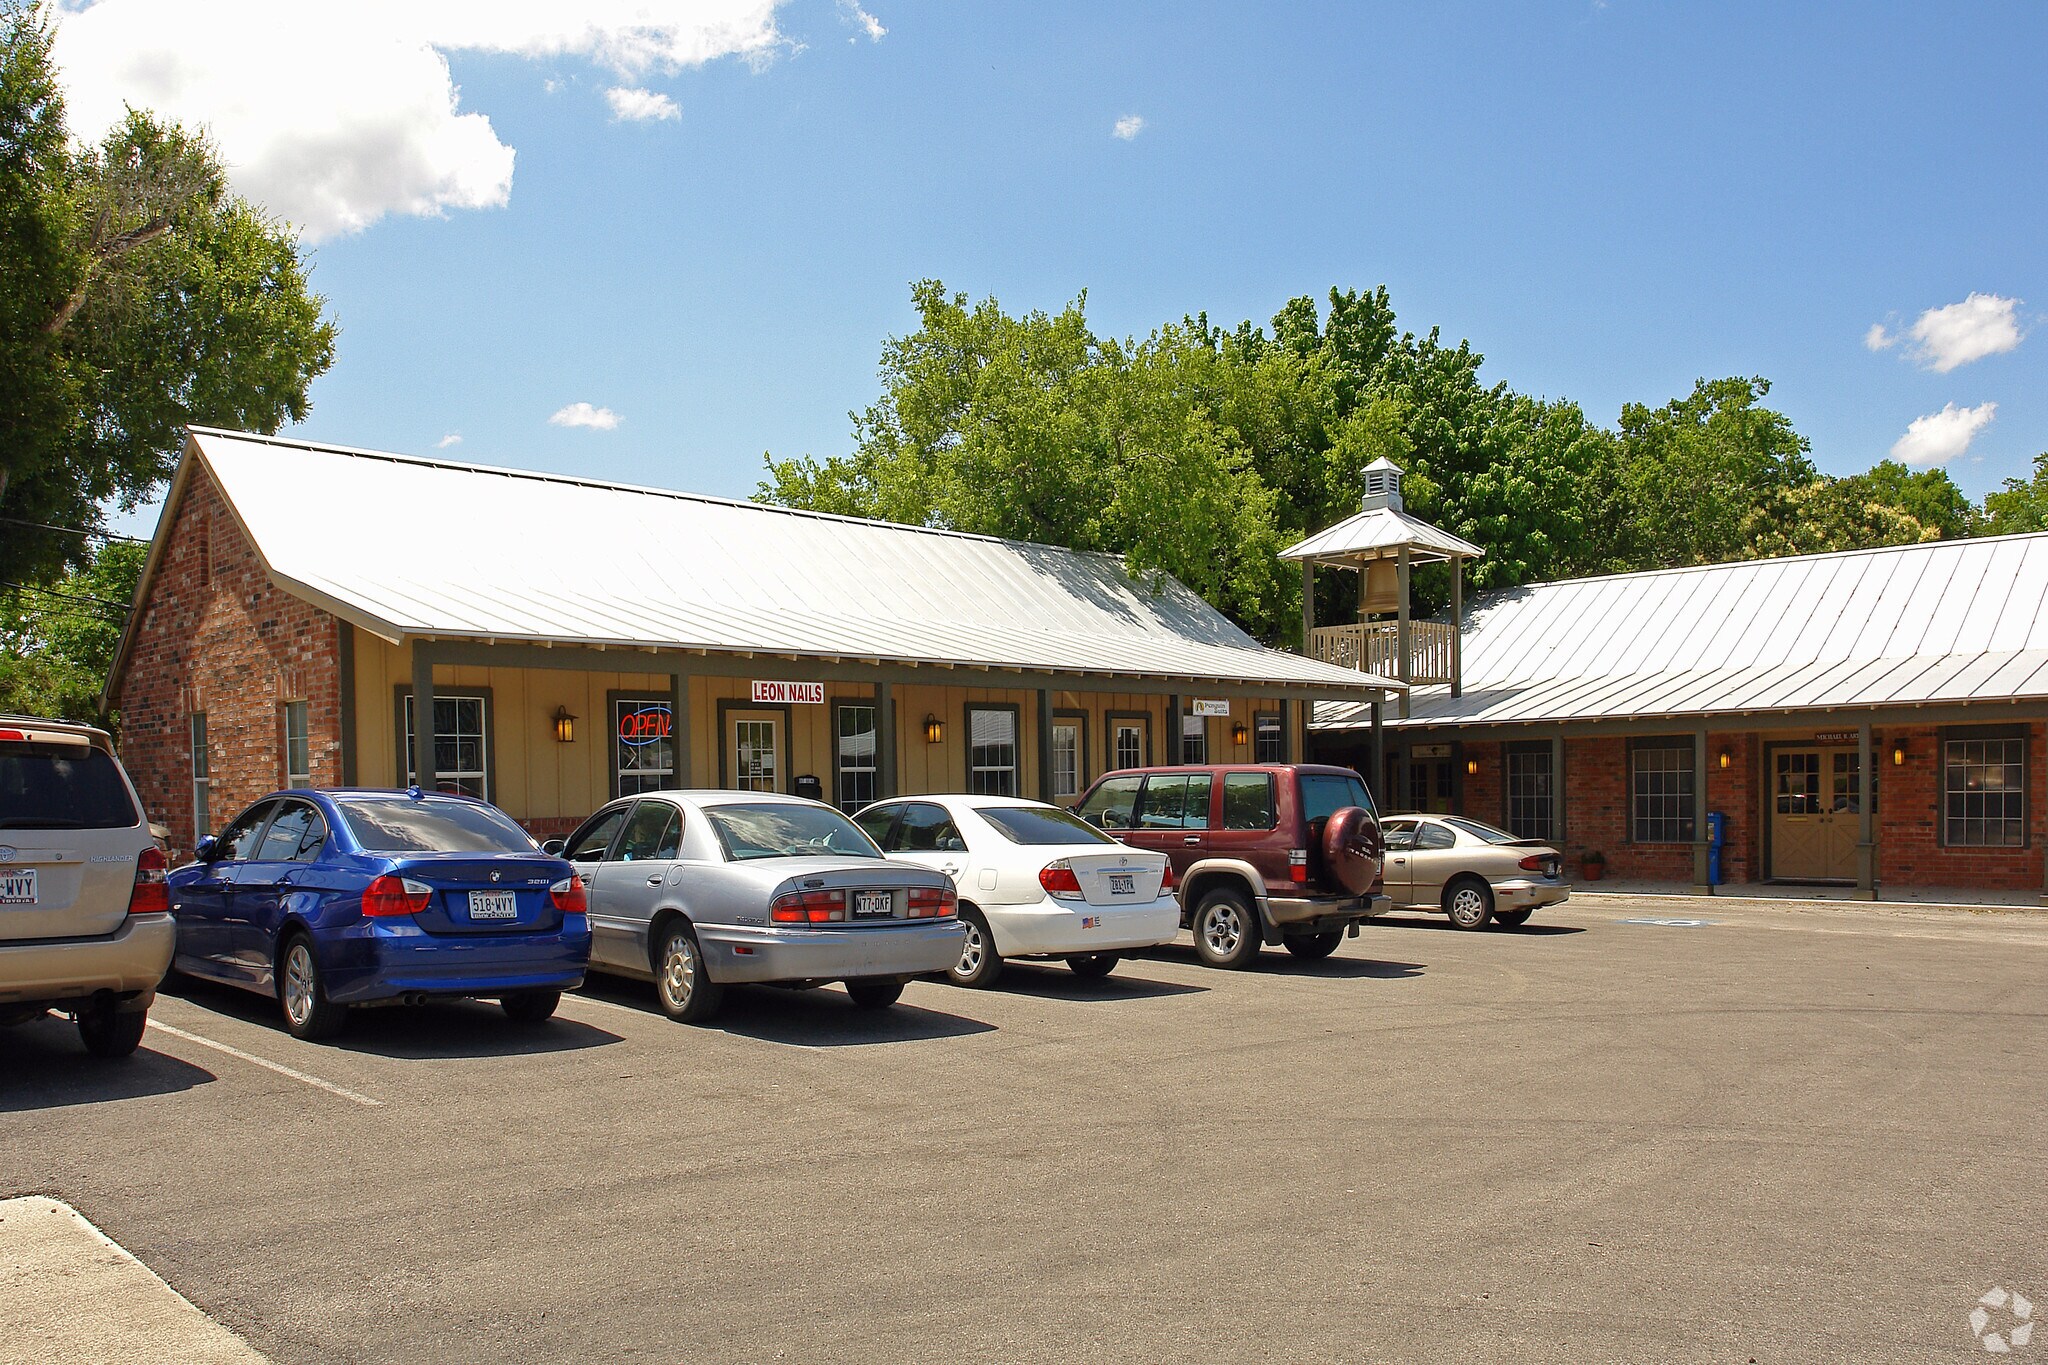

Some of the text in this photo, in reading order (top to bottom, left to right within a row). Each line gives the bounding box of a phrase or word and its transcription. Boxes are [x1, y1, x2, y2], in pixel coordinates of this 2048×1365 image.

[754, 683, 822, 703] LEON NAILS
[620, 713, 671, 739] OPEN
